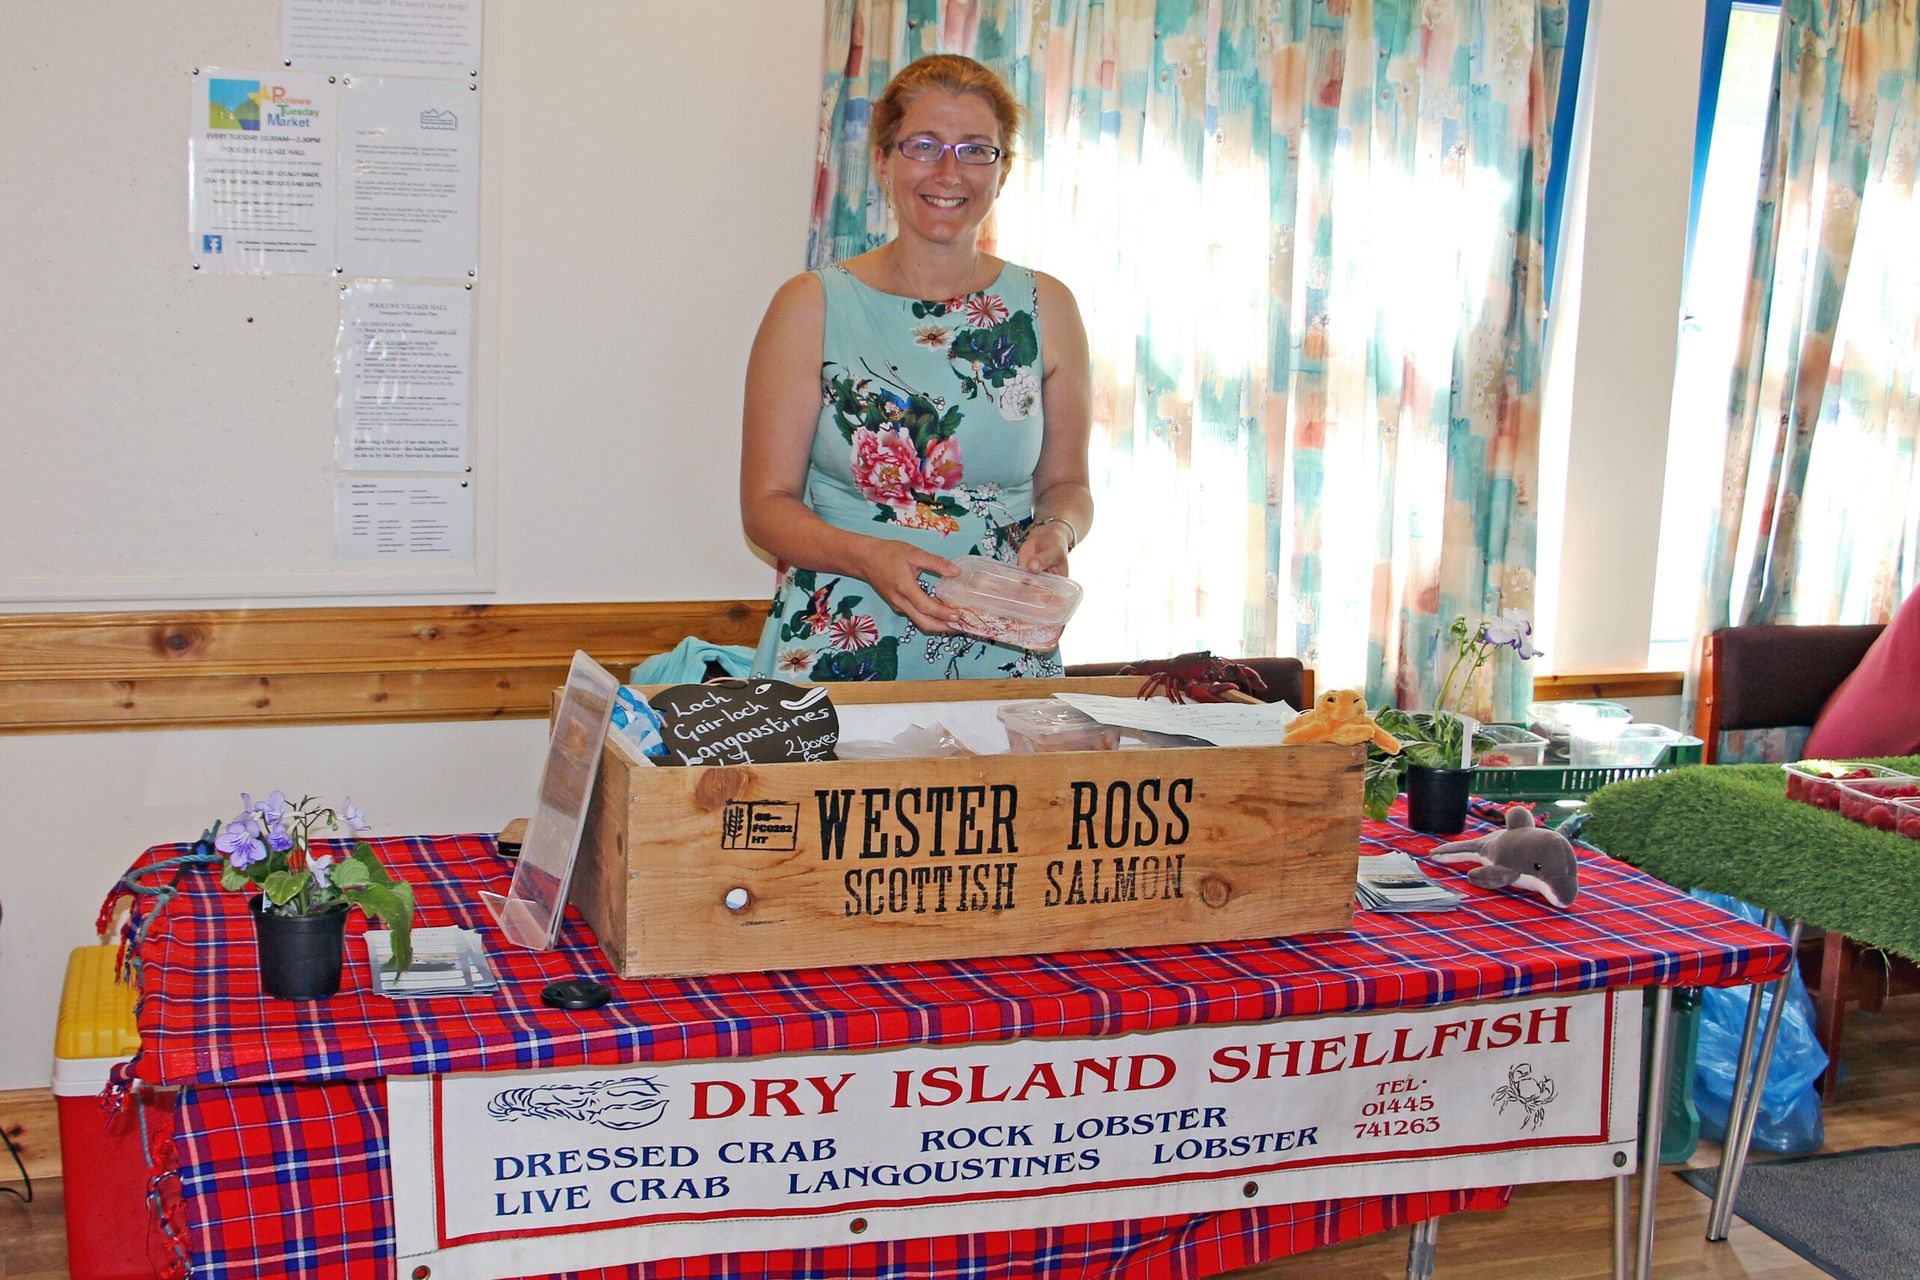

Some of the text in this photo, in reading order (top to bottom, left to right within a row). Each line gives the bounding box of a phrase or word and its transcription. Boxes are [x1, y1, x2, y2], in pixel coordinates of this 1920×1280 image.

[267, 113, 310, 127] Market
[276, 104, 319, 117] Tuesday
[671, 691, 732, 718] Loch
[673, 700, 769, 742] Gairloch
[677, 707, 830, 766] Langoustines
[785, 731, 837, 757] 2 boxes
[815, 778, 1194, 861] WESTER ROSS
[751, 835, 769, 844] HT
[844, 854, 1186, 918] SCOTTISH SALMON
[690, 1005, 1572, 1120] DRY ISLAND SHELLFISH
[1361, 1095, 1435, 1117] 01445
[494, 1107, 1227, 1182] DRESSED CRAB ROCK LOBSTER
[1354, 1116, 1440, 1140] 741263
[495, 1126, 1319, 1217] LIVE CRAB LANGOUSTINES LOBSTER
